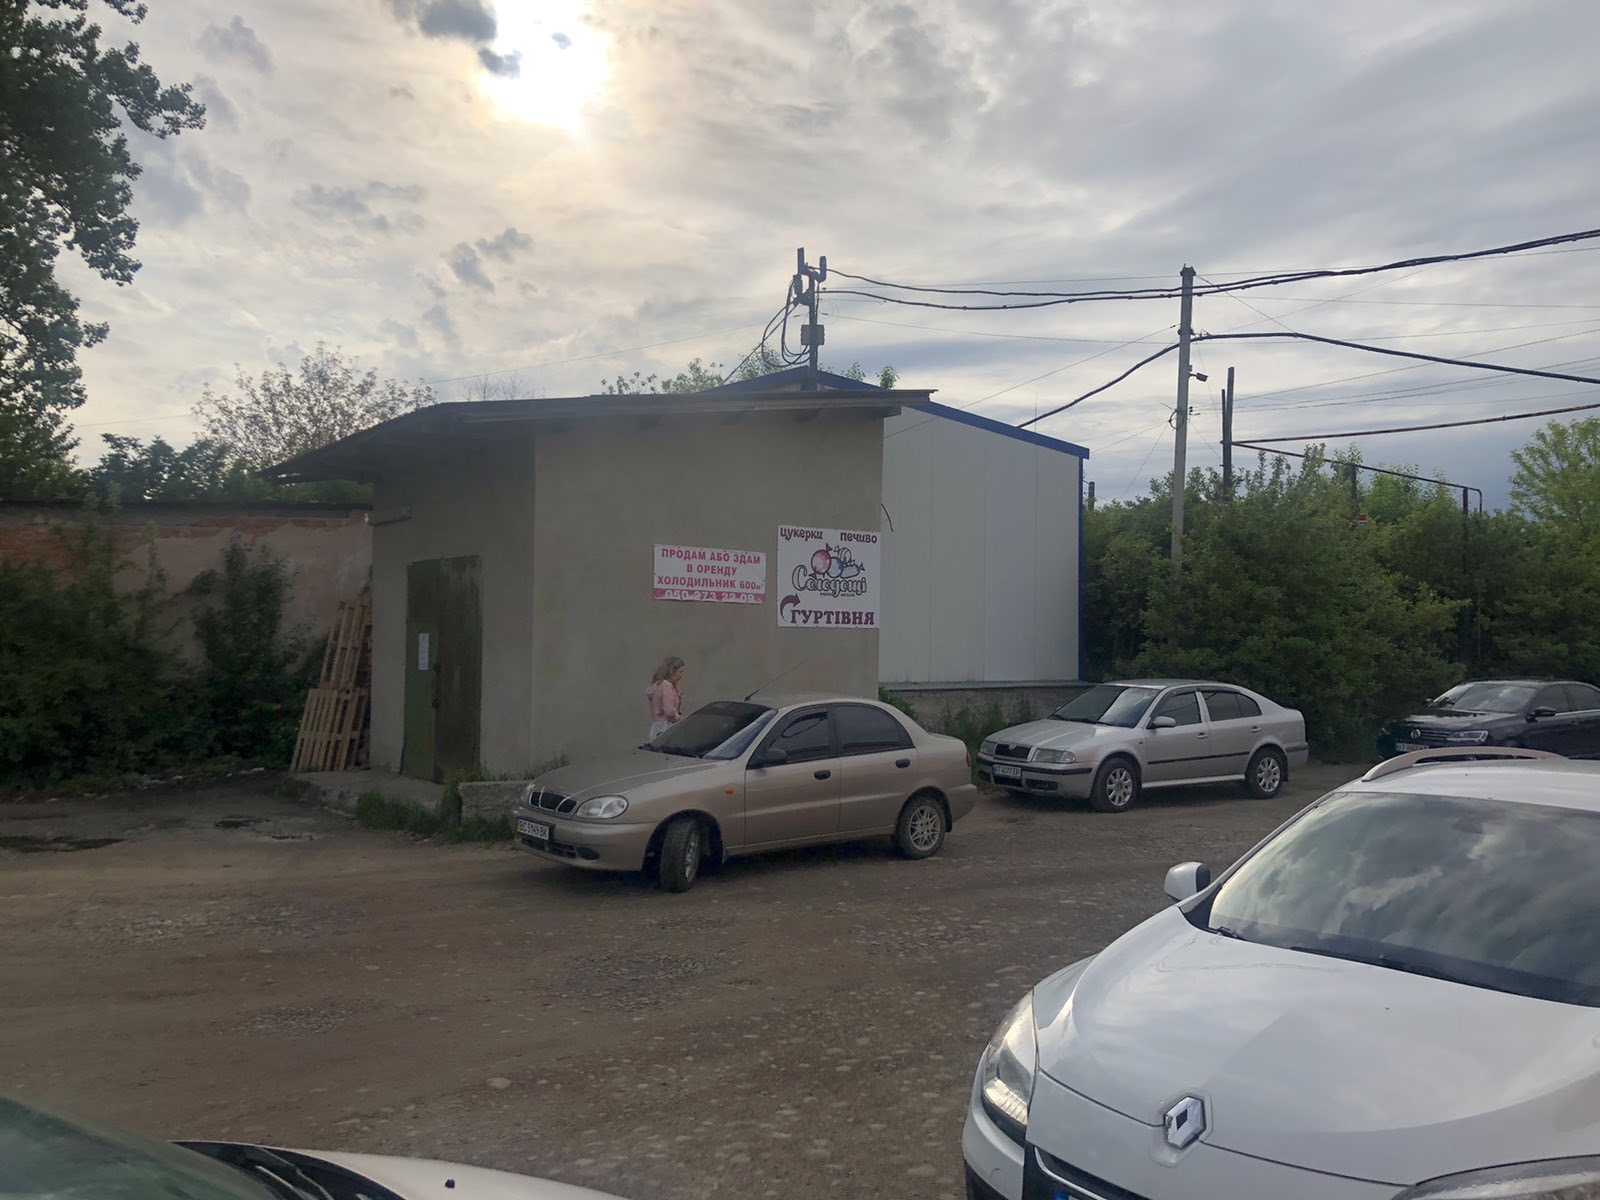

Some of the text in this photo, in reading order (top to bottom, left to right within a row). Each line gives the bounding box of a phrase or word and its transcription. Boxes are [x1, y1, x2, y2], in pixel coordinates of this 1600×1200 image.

[840, 532, 878, 544] печиво
[661, 548, 760, 565] ПРОДАМ АБО ЗДАМ
[686, 563, 737, 577] В ОРЕНДУ
[657, 575, 736, 589] ХОЛОДИЛЬНИК
[790, 609, 875, 625] ГУРТІВНЯ
